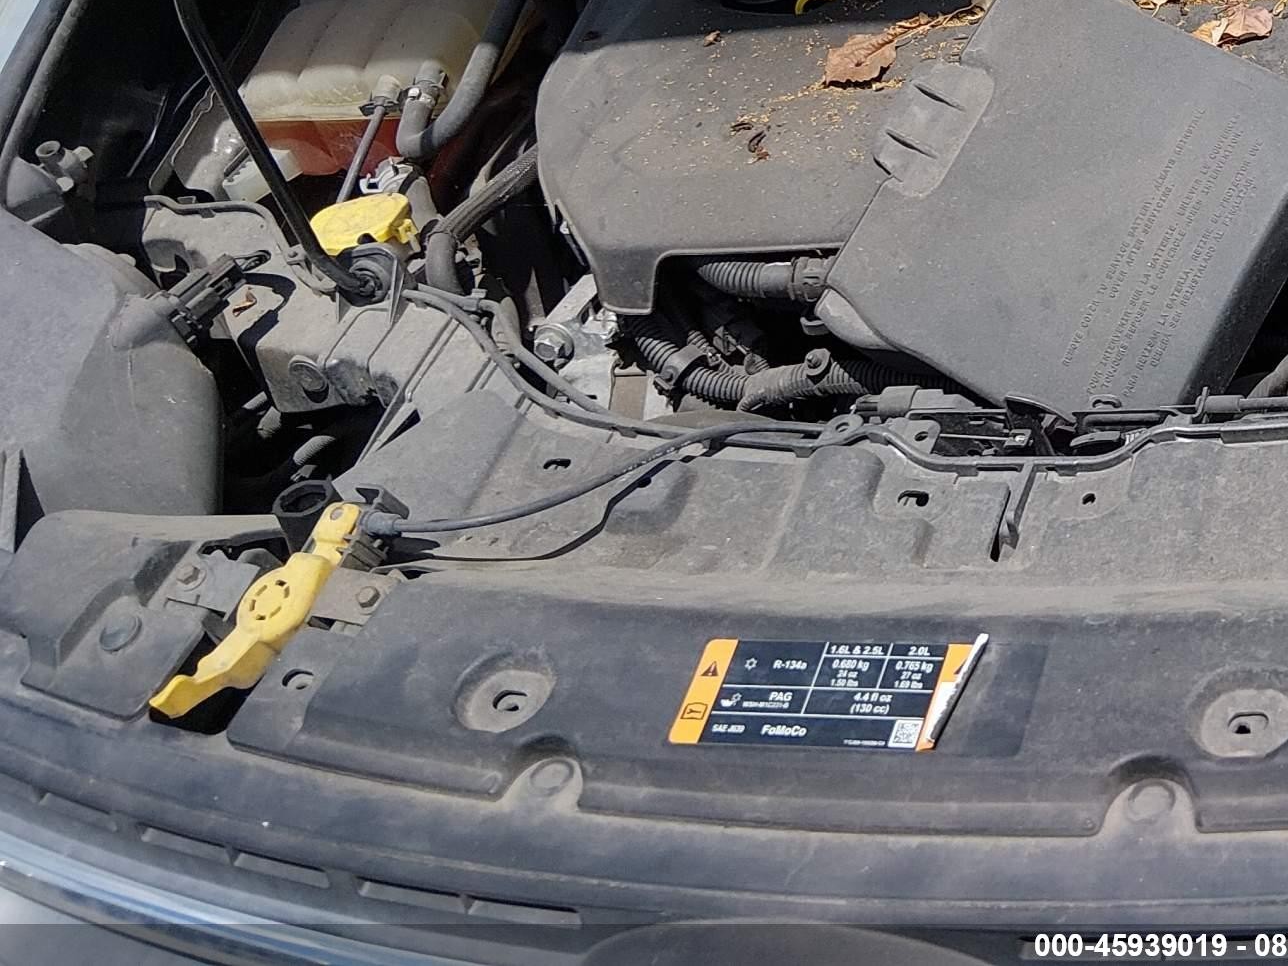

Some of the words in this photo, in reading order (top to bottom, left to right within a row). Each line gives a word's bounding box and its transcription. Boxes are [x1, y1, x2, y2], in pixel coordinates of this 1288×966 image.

[1059, 331, 1085, 367] REMOVE
[1078, 297, 1102, 330] COVER
[1095, 282, 1109, 297] TO
[1103, 239, 1132, 281] SERVICE
[1151, 156, 1177, 192] ALWAYS
[1106, 269, 1128, 299] COVER
[1122, 236, 1145, 267] AFTER
[1084, 368, 1104, 395] POUR
[1128, 287, 1144, 307] SUR
[1139, 271, 1152, 286] LA
[1175, 176, 1203, 217] ENLEVER
[1199, 162, 1211, 176] LE
[1120, 372, 1140, 398] PARA
[1133, 328, 1162, 371] REVISAR
[1156, 311, 1169, 326] LA
[1189, 226, 1214, 261] RETIRE
[1218, 158, 1251, 209] PROTECTOR
[1166, 309, 1183, 329] SER
[1212, 229, 1225, 243] AL
[1097, 341, 1131, 391] TOUJOURS
[1123, 298, 1151, 340] REPOSER
[1146, 282, 1159, 296] LE
[830, 645, 850, 654] 1.6L
[852, 646, 861, 654] &
[862, 646, 884, 655] 2.5L
[909, 646, 930, 655] 2.0L
[773, 659, 807, 670] R-134a
[857, 660, 870, 672] kg
[895, 661, 921, 671] 0.765
[921, 662, 934, 673] kg
[900, 672, 911, 680] 27
[769, 692, 792, 701] PAG
[853, 693, 869, 702] 4.4
[870, 693, 879, 702] fl
[880, 694, 893, 702] oz
[850, 703, 873, 714] (130
[873, 704, 889, 714] cc)
[761, 724, 807, 736] FoMoCo
